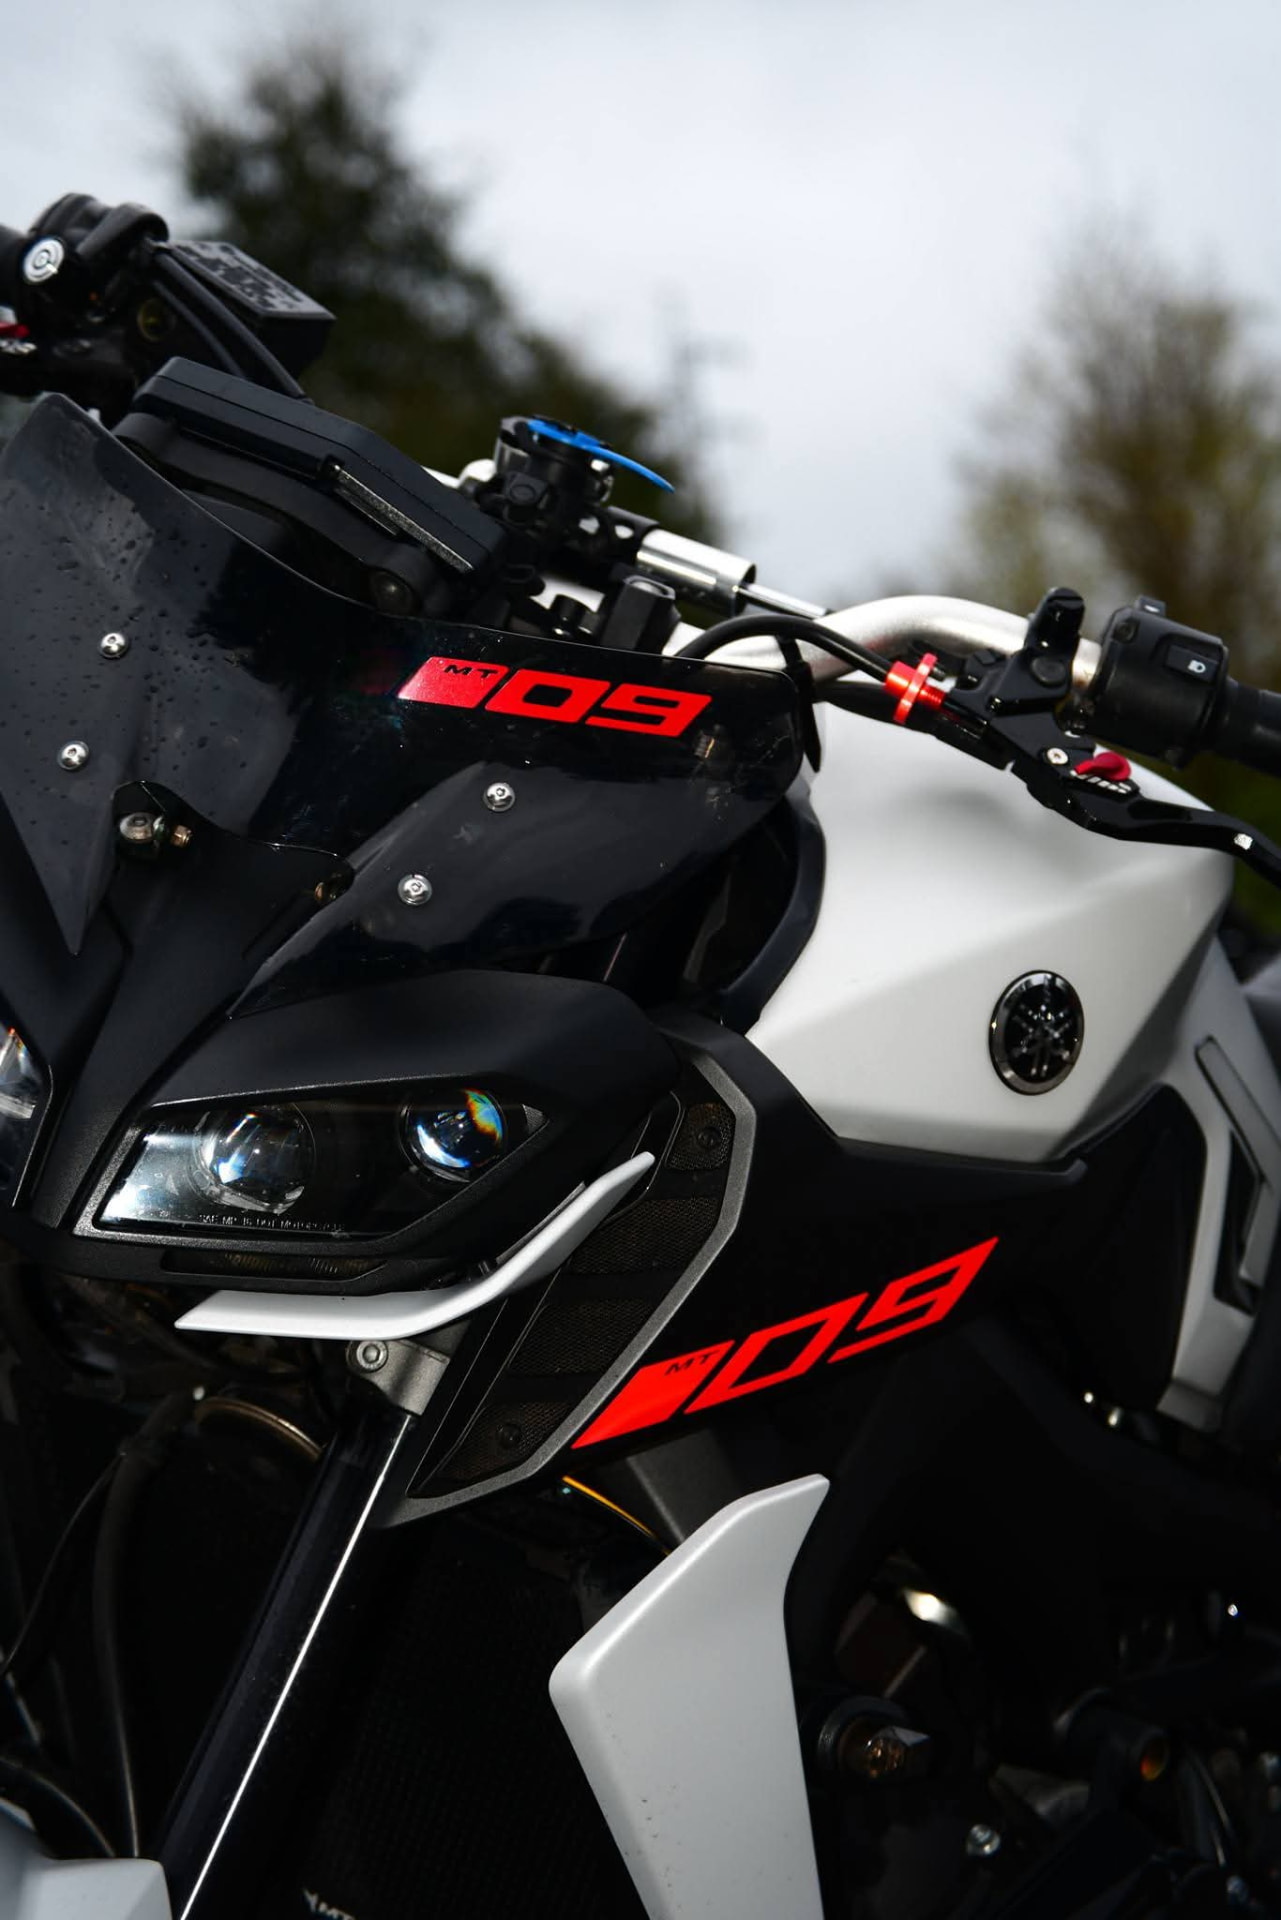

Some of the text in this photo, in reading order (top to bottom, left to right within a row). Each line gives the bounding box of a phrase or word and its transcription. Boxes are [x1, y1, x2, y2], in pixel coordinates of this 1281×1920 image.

[444, 664, 713, 737] MT 09
[664, 1236, 999, 1415] MT 09
